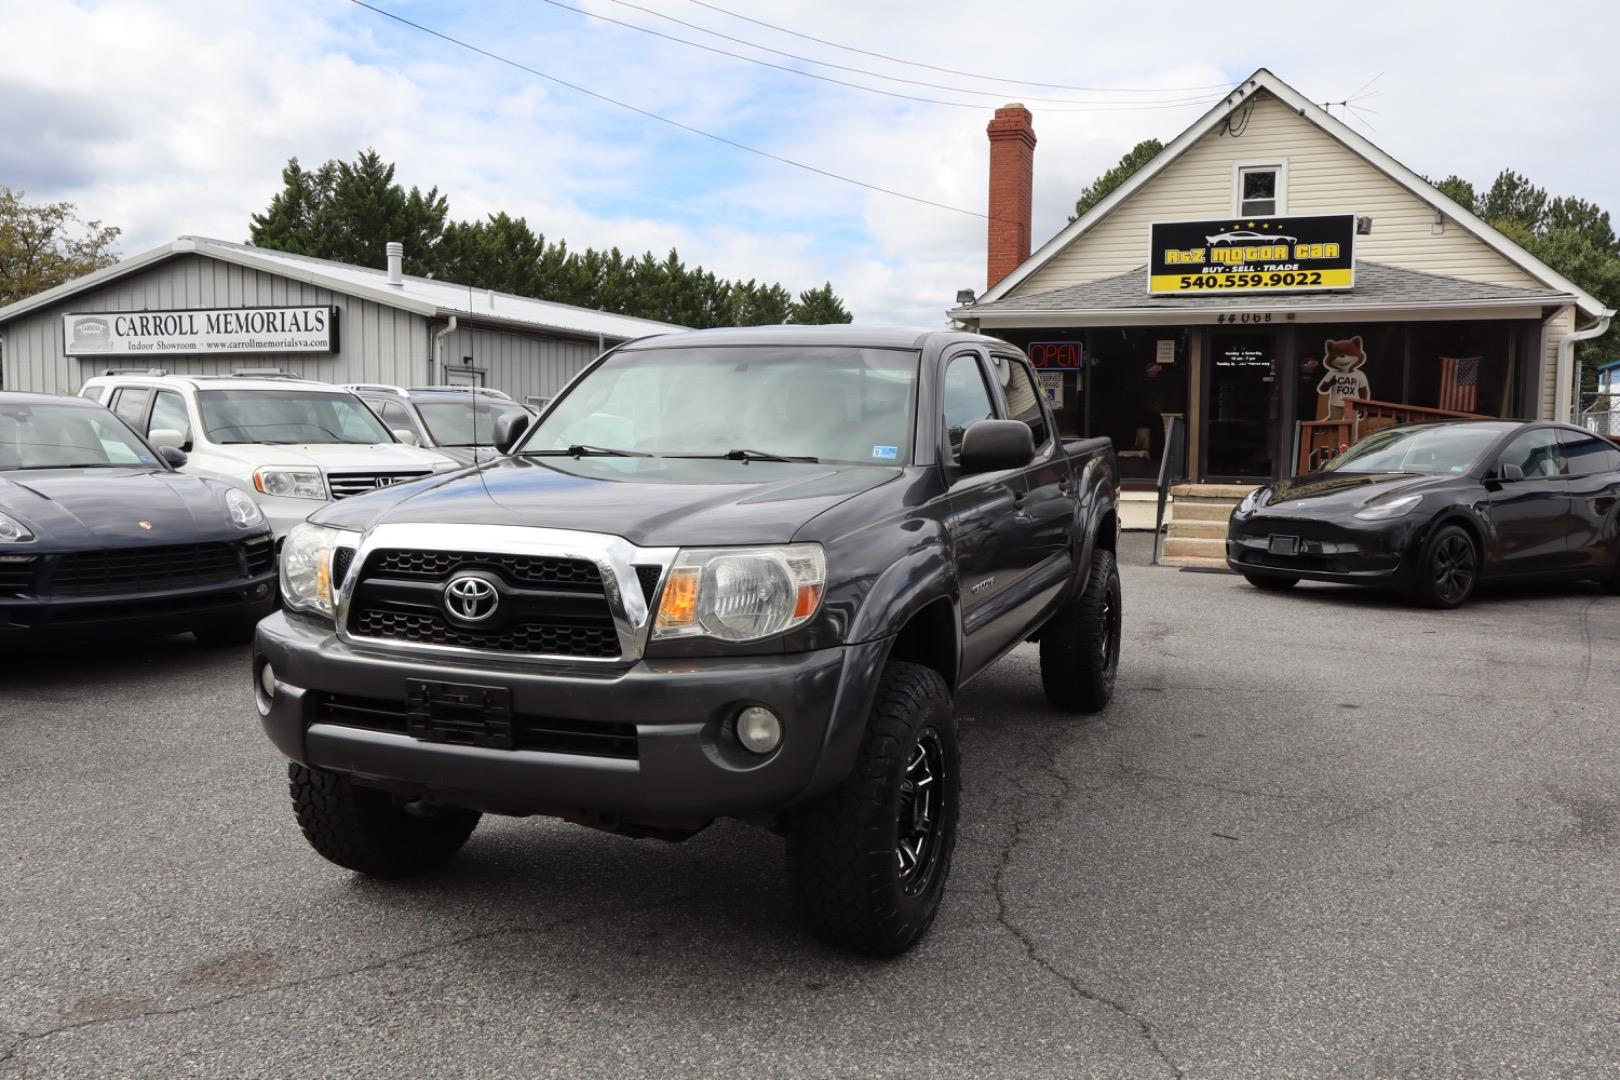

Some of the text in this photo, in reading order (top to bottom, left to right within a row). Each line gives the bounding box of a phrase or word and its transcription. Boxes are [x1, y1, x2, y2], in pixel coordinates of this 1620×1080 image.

[1202, 264, 1299, 274] BUY SELL TRADE
[1180, 272, 1322, 289] 540.559.9022
[115, 310, 325, 336] CARROLL MEMORIALS
[128, 338, 328, 350] Indoor Showroom www.carrollmemorialsva.com
[1030, 343, 1081, 368] OPEN
[1338, 376, 1357, 386] CAR
[1337, 385, 1356, 396] FOX
